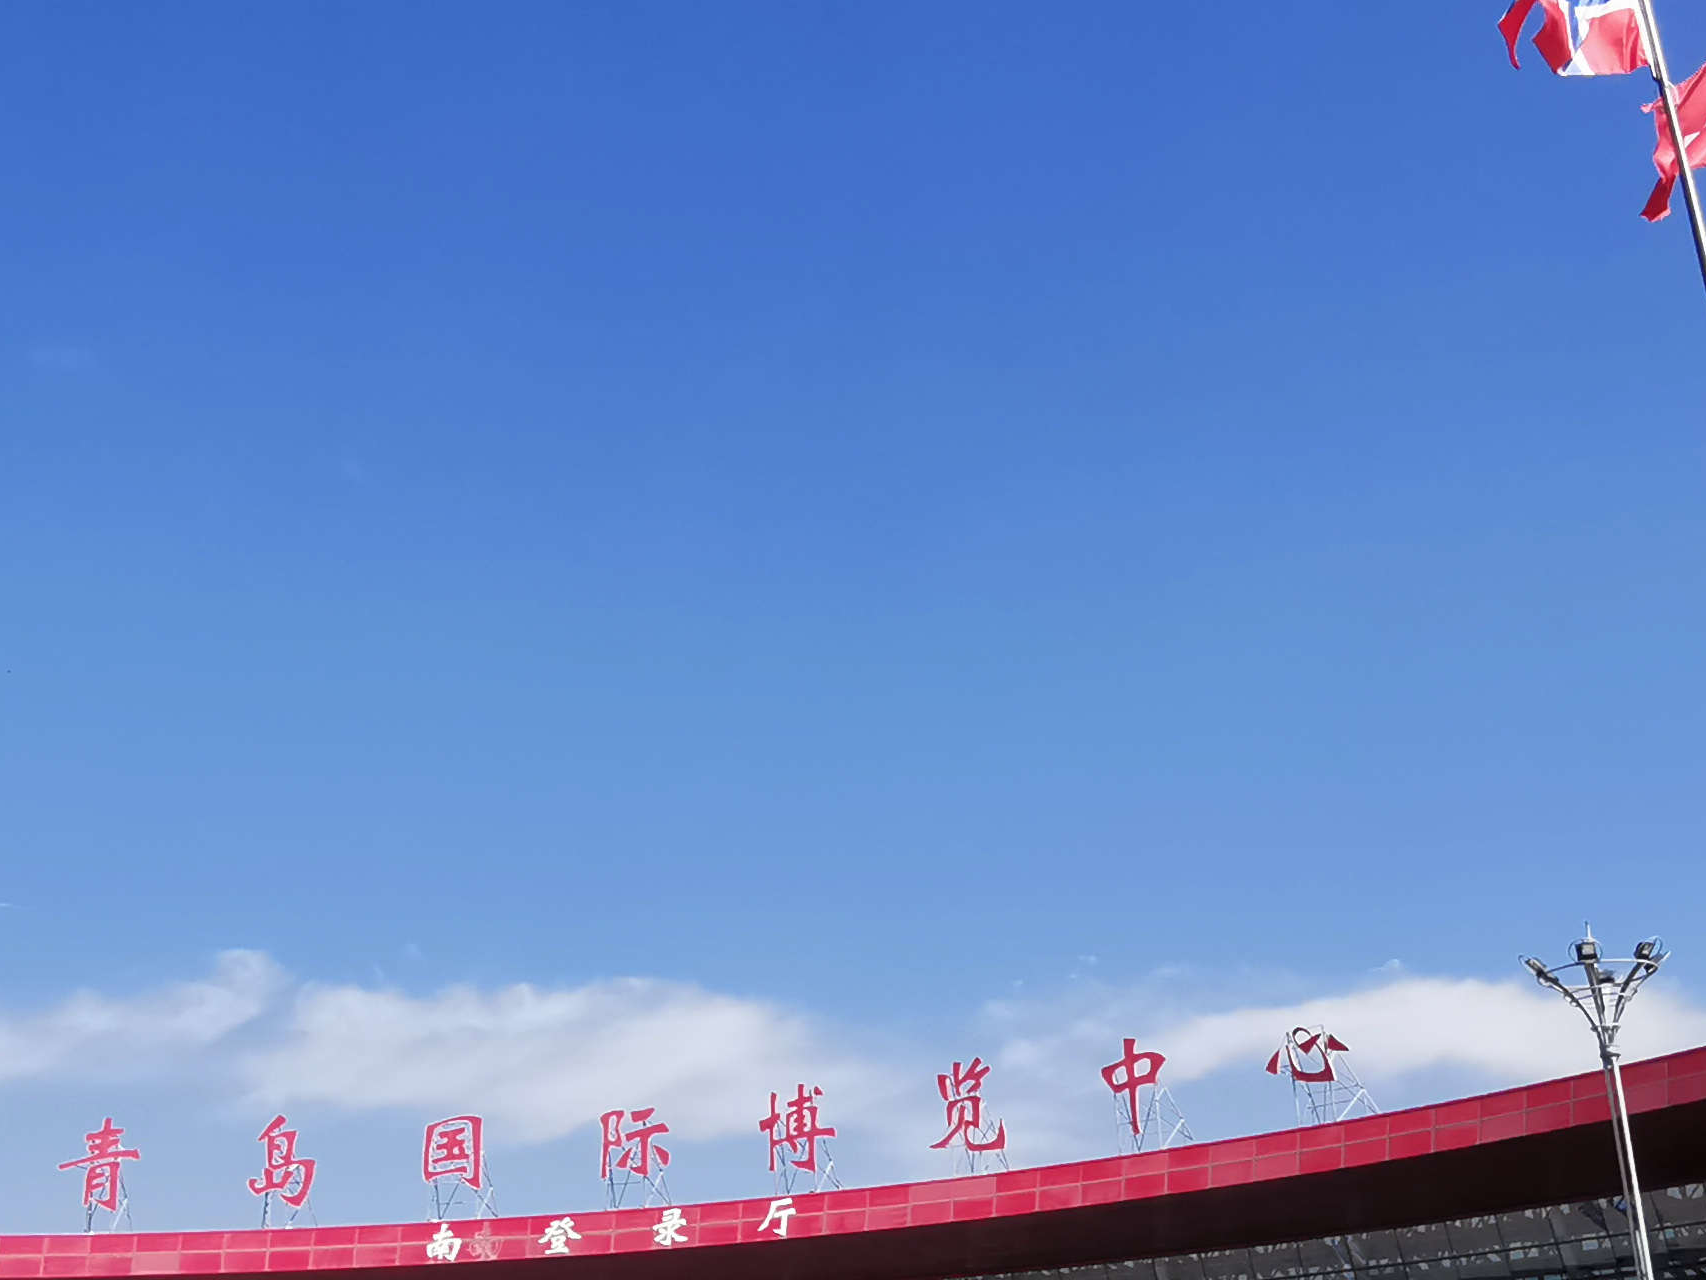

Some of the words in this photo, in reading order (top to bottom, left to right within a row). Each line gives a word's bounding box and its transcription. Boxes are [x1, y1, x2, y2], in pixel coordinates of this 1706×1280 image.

[58, 1025, 1351, 1212] 青岛国际博览中心
[425, 1197, 797, 1262] 南登录厅
